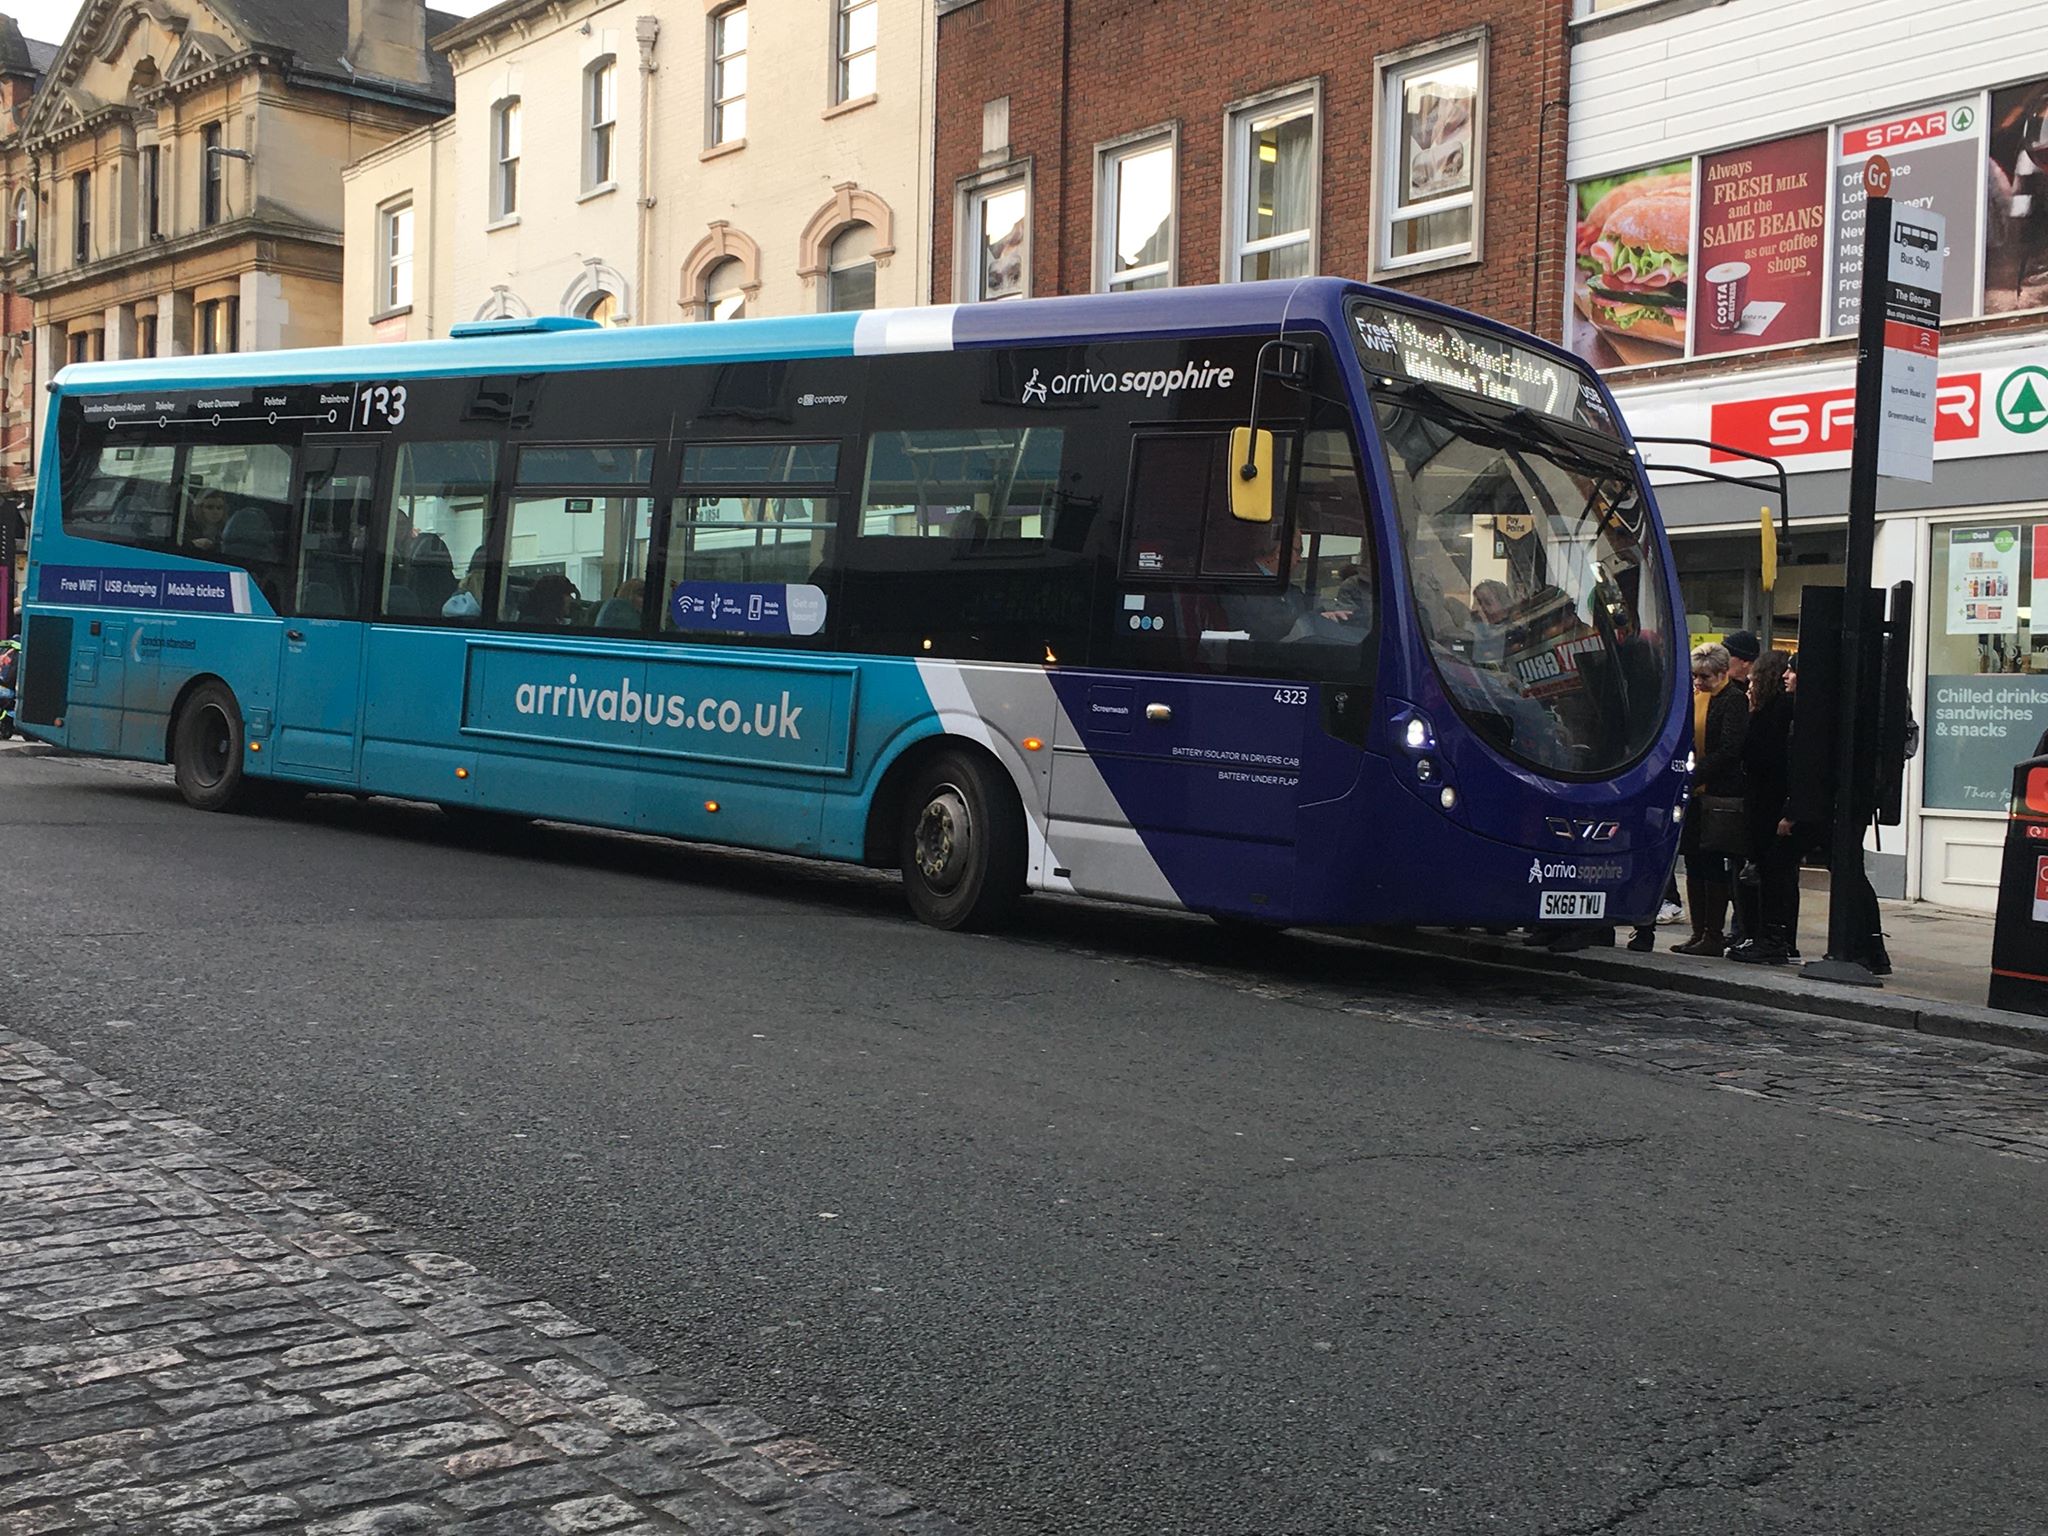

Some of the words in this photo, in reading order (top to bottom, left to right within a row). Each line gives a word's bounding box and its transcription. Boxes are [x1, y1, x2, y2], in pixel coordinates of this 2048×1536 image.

[1866, 115, 1945, 147] SPAR
[1708, 160, 1752, 182] Always
[1713, 173, 1773, 205] FRESH
[1776, 173, 1808, 193] MILK
[1728, 201, 1750, 219] and
[1753, 198, 1773, 214] the
[1703, 219, 1755, 248] SAME
[1759, 205, 1823, 238] BEANS
[1744, 247, 1757, 260] as
[1759, 244, 1777, 257] our
[1779, 233, 1818, 254] coffee
[1768, 255, 1807, 274] shops
[1900, 252, 1914, 265] Bus
[1916, 256, 1930, 271] Stop
[1717, 284, 1728, 324] COSTA
[1895, 288, 1908, 301] The
[1909, 292, 1932, 308] George
[1355, 317, 1389, 337] Free
[1360, 332, 1398, 355] WiFi
[1051, 368, 1117, 394] arriva
[1119, 360, 1234, 398] sapphire
[264, 396, 286, 406] Felsted
[320, 394, 350, 404] Braintree
[815, 396, 848, 405] company
[1579, 383, 1602, 403] USB
[1910, 389, 1920, 398] Road
[84, 405, 102, 413] London
[127, 403, 146, 413] Airport
[197, 400, 213, 408] Great
[214, 399, 240, 408] Dunmow
[360, 385, 407, 426] 133
[1768, 385, 1975, 446] SPR
[61, 578, 78, 591] Free
[79, 579, 97, 591] WiFi
[104, 579, 122, 592] USB
[123, 582, 157, 597] charging
[168, 583, 195, 597] Mobile
[196, 585, 225, 598] tickets
[792, 599, 807, 608] Get
[1273, 689, 1308, 705] 4323
[1937, 688, 1993, 703] Chilled
[1996, 688, 2048, 704] drinks
[515, 673, 803, 740] arrivabus.co.uk
[1092, 704, 1129, 714] Screenwash
[1936, 705, 2033, 721] sandwiches
[1936, 722, 1948, 736] &
[1950, 722, 2007, 737] snacks
[1172, 747, 1203, 757] BATTERY
[1204, 750, 1239, 760] ISOLATOR
[1241, 753, 1249, 761] IN
[1250, 754, 1282, 765] DRIVERS
[1283, 757, 1300, 767] CAB
[1218, 771, 1250, 782] BATTERY
[1251, 774, 1278, 785] UNDER
[1278, 776, 1299, 787] FLAP
[1963, 785, 1997, 799] There
[1544, 861, 1576, 878] arriva
[1577, 860, 1623, 883] sapphire
[1545, 895, 1576, 915] SK68
[1579, 895, 1601, 915] TWU
